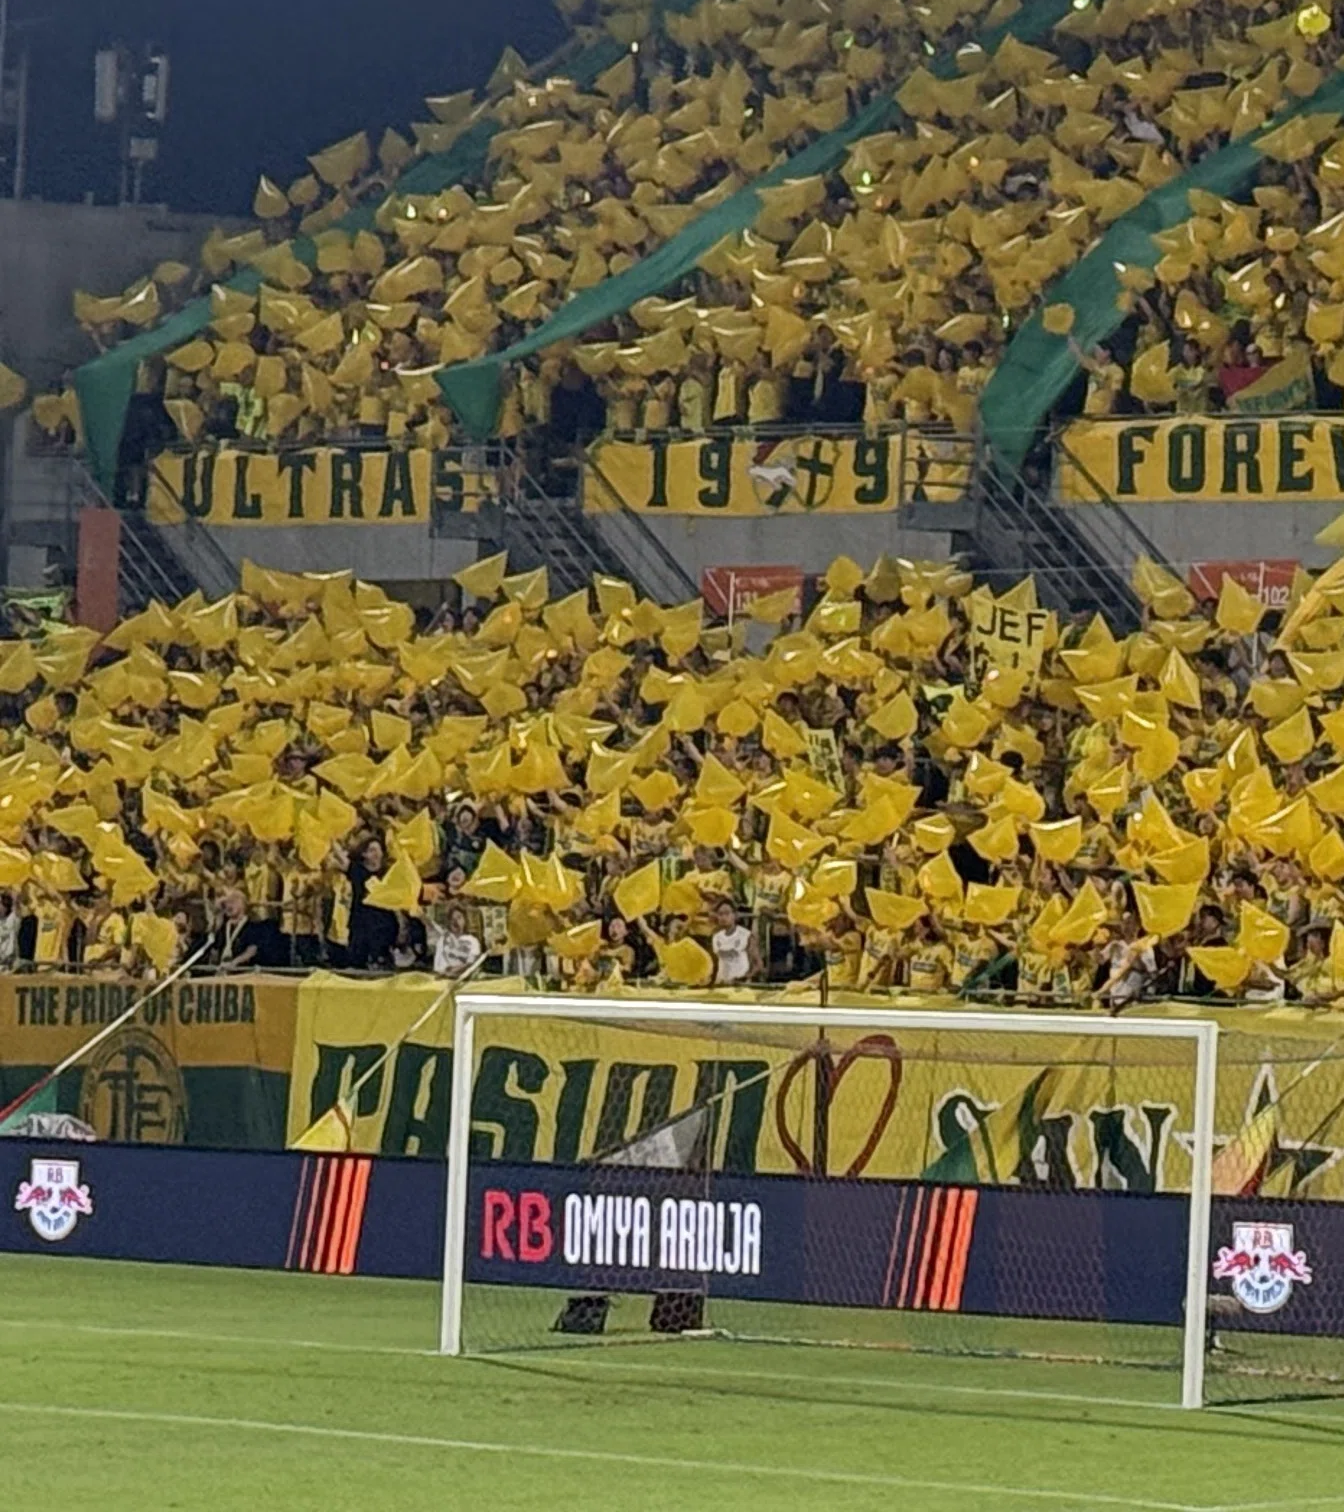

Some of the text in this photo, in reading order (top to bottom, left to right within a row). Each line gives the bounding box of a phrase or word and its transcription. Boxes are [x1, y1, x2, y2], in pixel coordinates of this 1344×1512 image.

[181, 445, 465, 519] ULTRAS
[976, 604, 1048, 646] JEF
[15, 982, 256, 1026] THE PRIDE OF CHIBA
[481, 1189, 761, 1275] RB OMIYA ARDIJA
